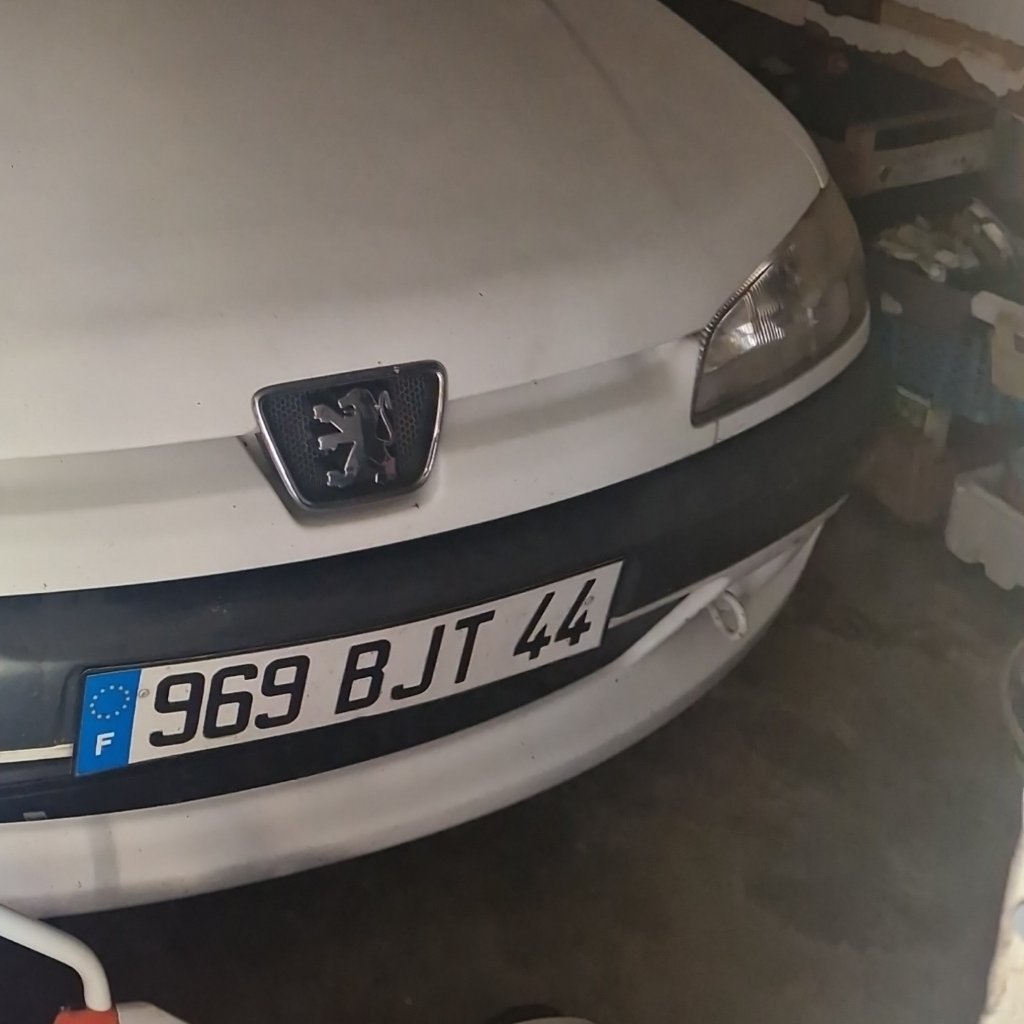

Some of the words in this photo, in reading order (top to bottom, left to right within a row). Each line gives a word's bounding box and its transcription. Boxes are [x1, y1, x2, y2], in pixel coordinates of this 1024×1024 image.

[148, 654, 310, 747] 969
[334, 610, 495, 715] BJT
[513, 577, 597, 660] 44
[94, 731, 115, 757] F
